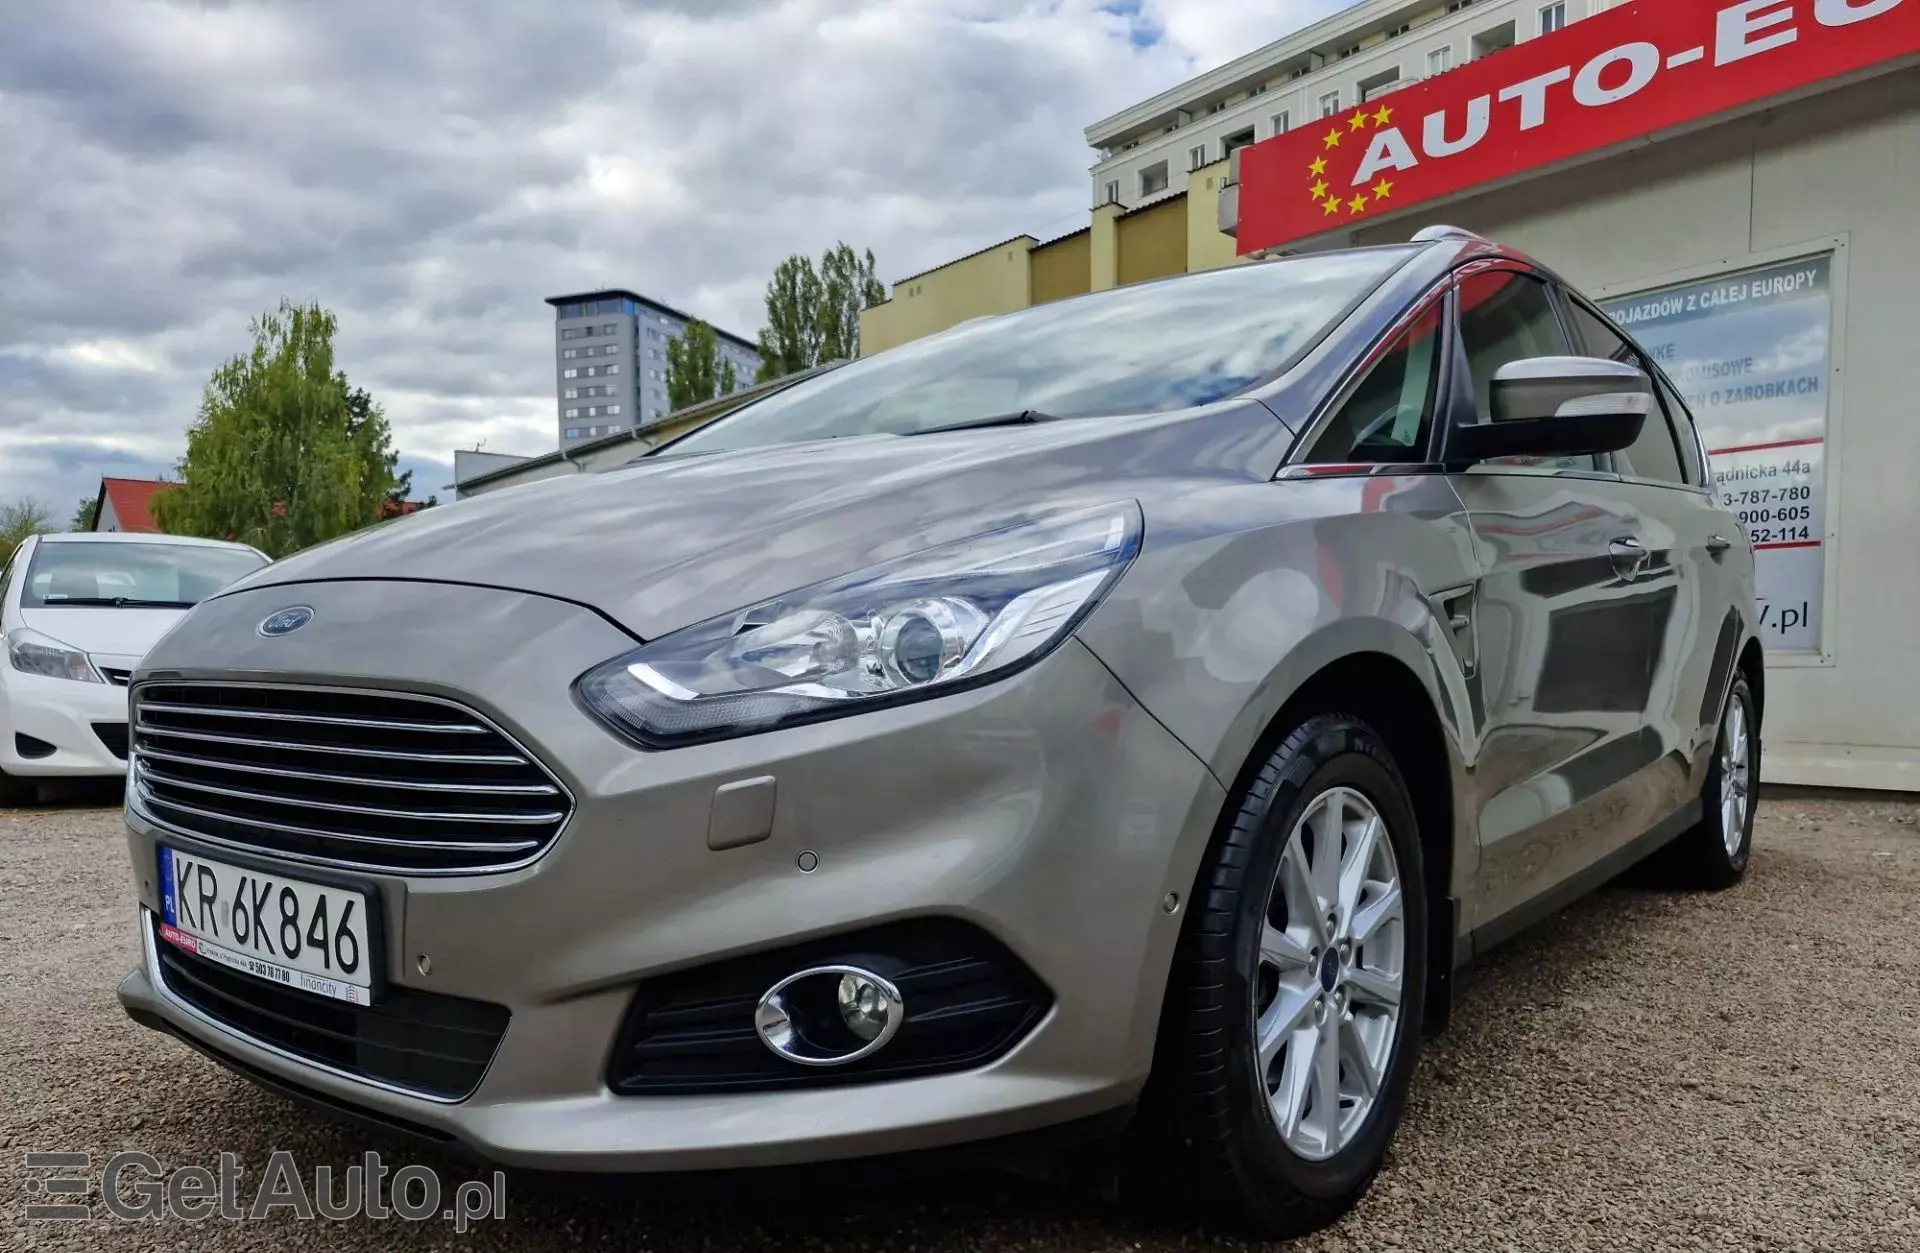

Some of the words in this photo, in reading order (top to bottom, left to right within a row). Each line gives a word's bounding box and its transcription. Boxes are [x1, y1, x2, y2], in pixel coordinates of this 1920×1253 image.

[1686, 294, 1696, 312] Z
[1700, 284, 1747, 308] CAŁEJ
[1752, 269, 1817, 298] EUROPY
[1710, 390, 1720, 407] O
[1724, 376, 1819, 405] ZAROBKACH
[1714, 463, 1777, 486] ądnicka
[1782, 459, 1811, 475] 44a
[1723, 486, 1810, 506] 3-787-780
[1739, 506, 1810, 524] 900-605
[1750, 526, 1809, 543] 52-114
[165, 894, 175, 913] PL
[176, 857, 219, 937] KR
[232, 876, 359, 974] 6K846
[165, 929, 196, 949] AUTO-EURO
[255, 962, 267, 976] 503
[282, 970, 290, 982] 80
